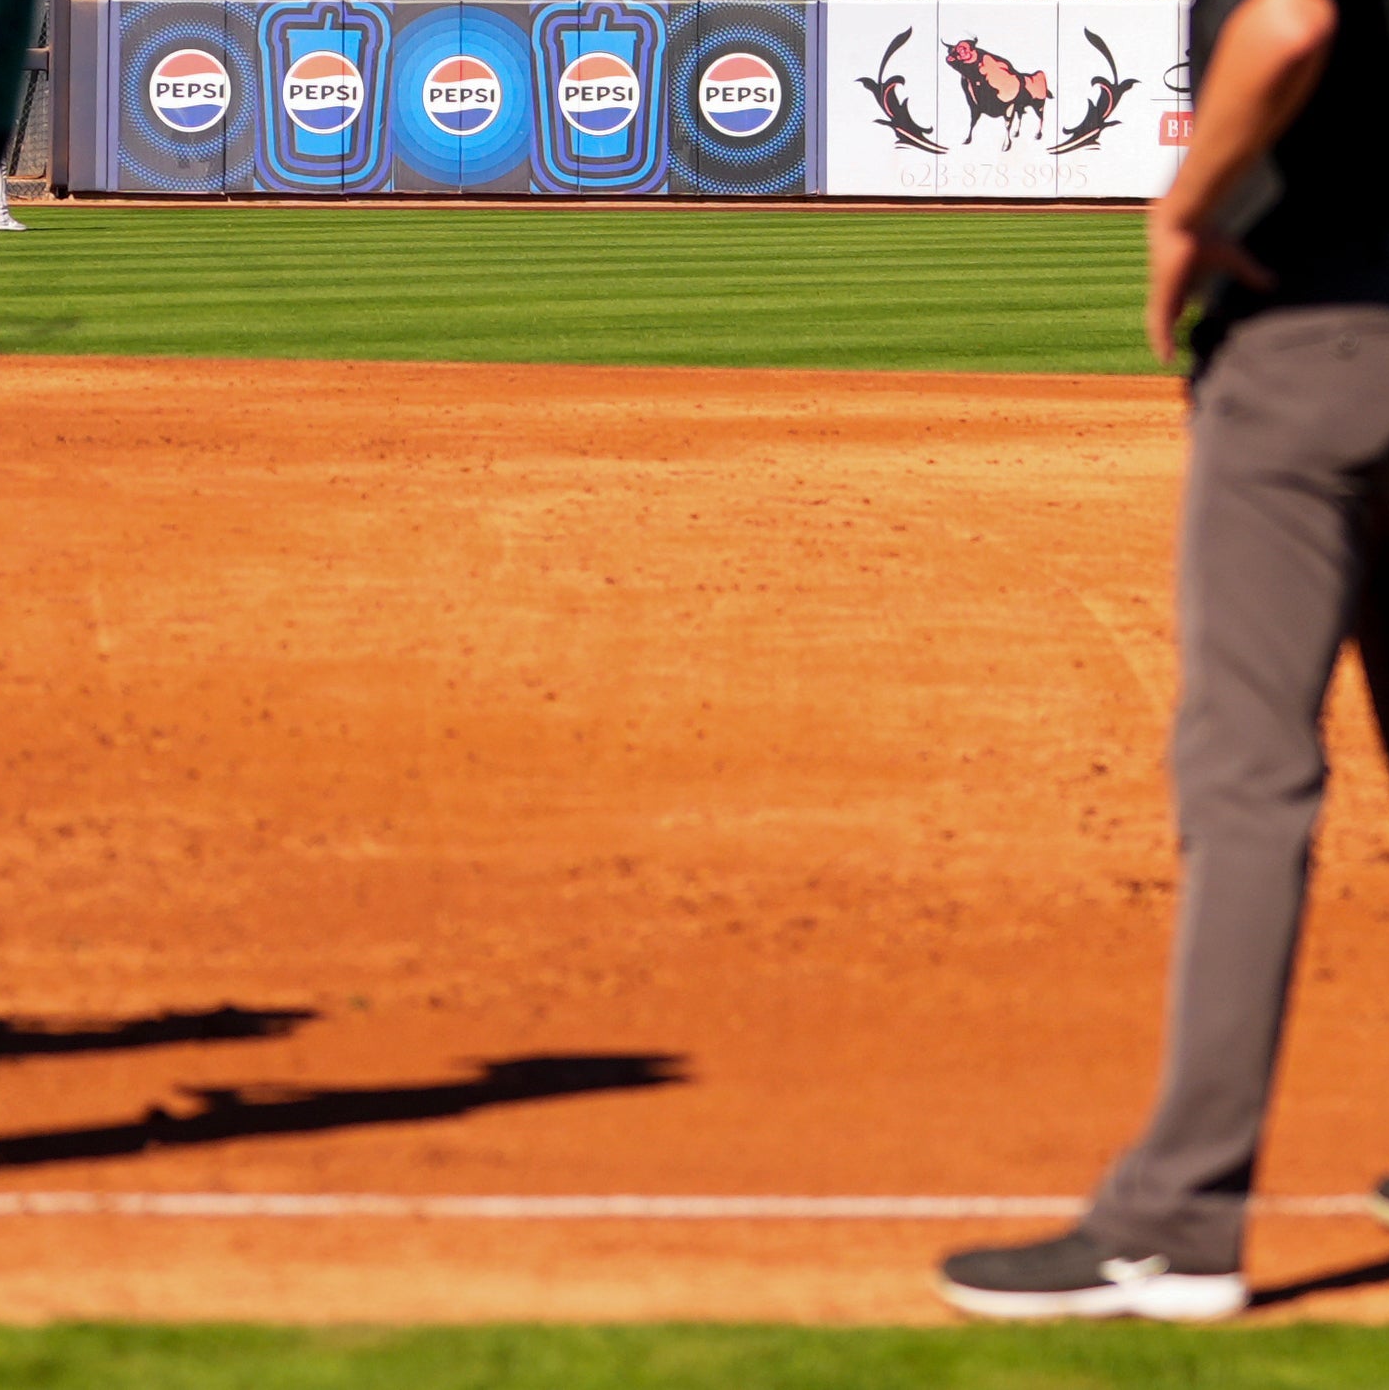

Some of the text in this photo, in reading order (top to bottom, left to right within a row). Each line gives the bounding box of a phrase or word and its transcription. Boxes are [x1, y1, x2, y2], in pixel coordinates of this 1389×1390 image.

[156, 82, 225, 100] PEPSI
[288, 84, 358, 102] PEPSI
[429, 87, 496, 105] PEPSI
[565, 86, 634, 103] PEPSI
[706, 85, 775, 103] PEPSI
